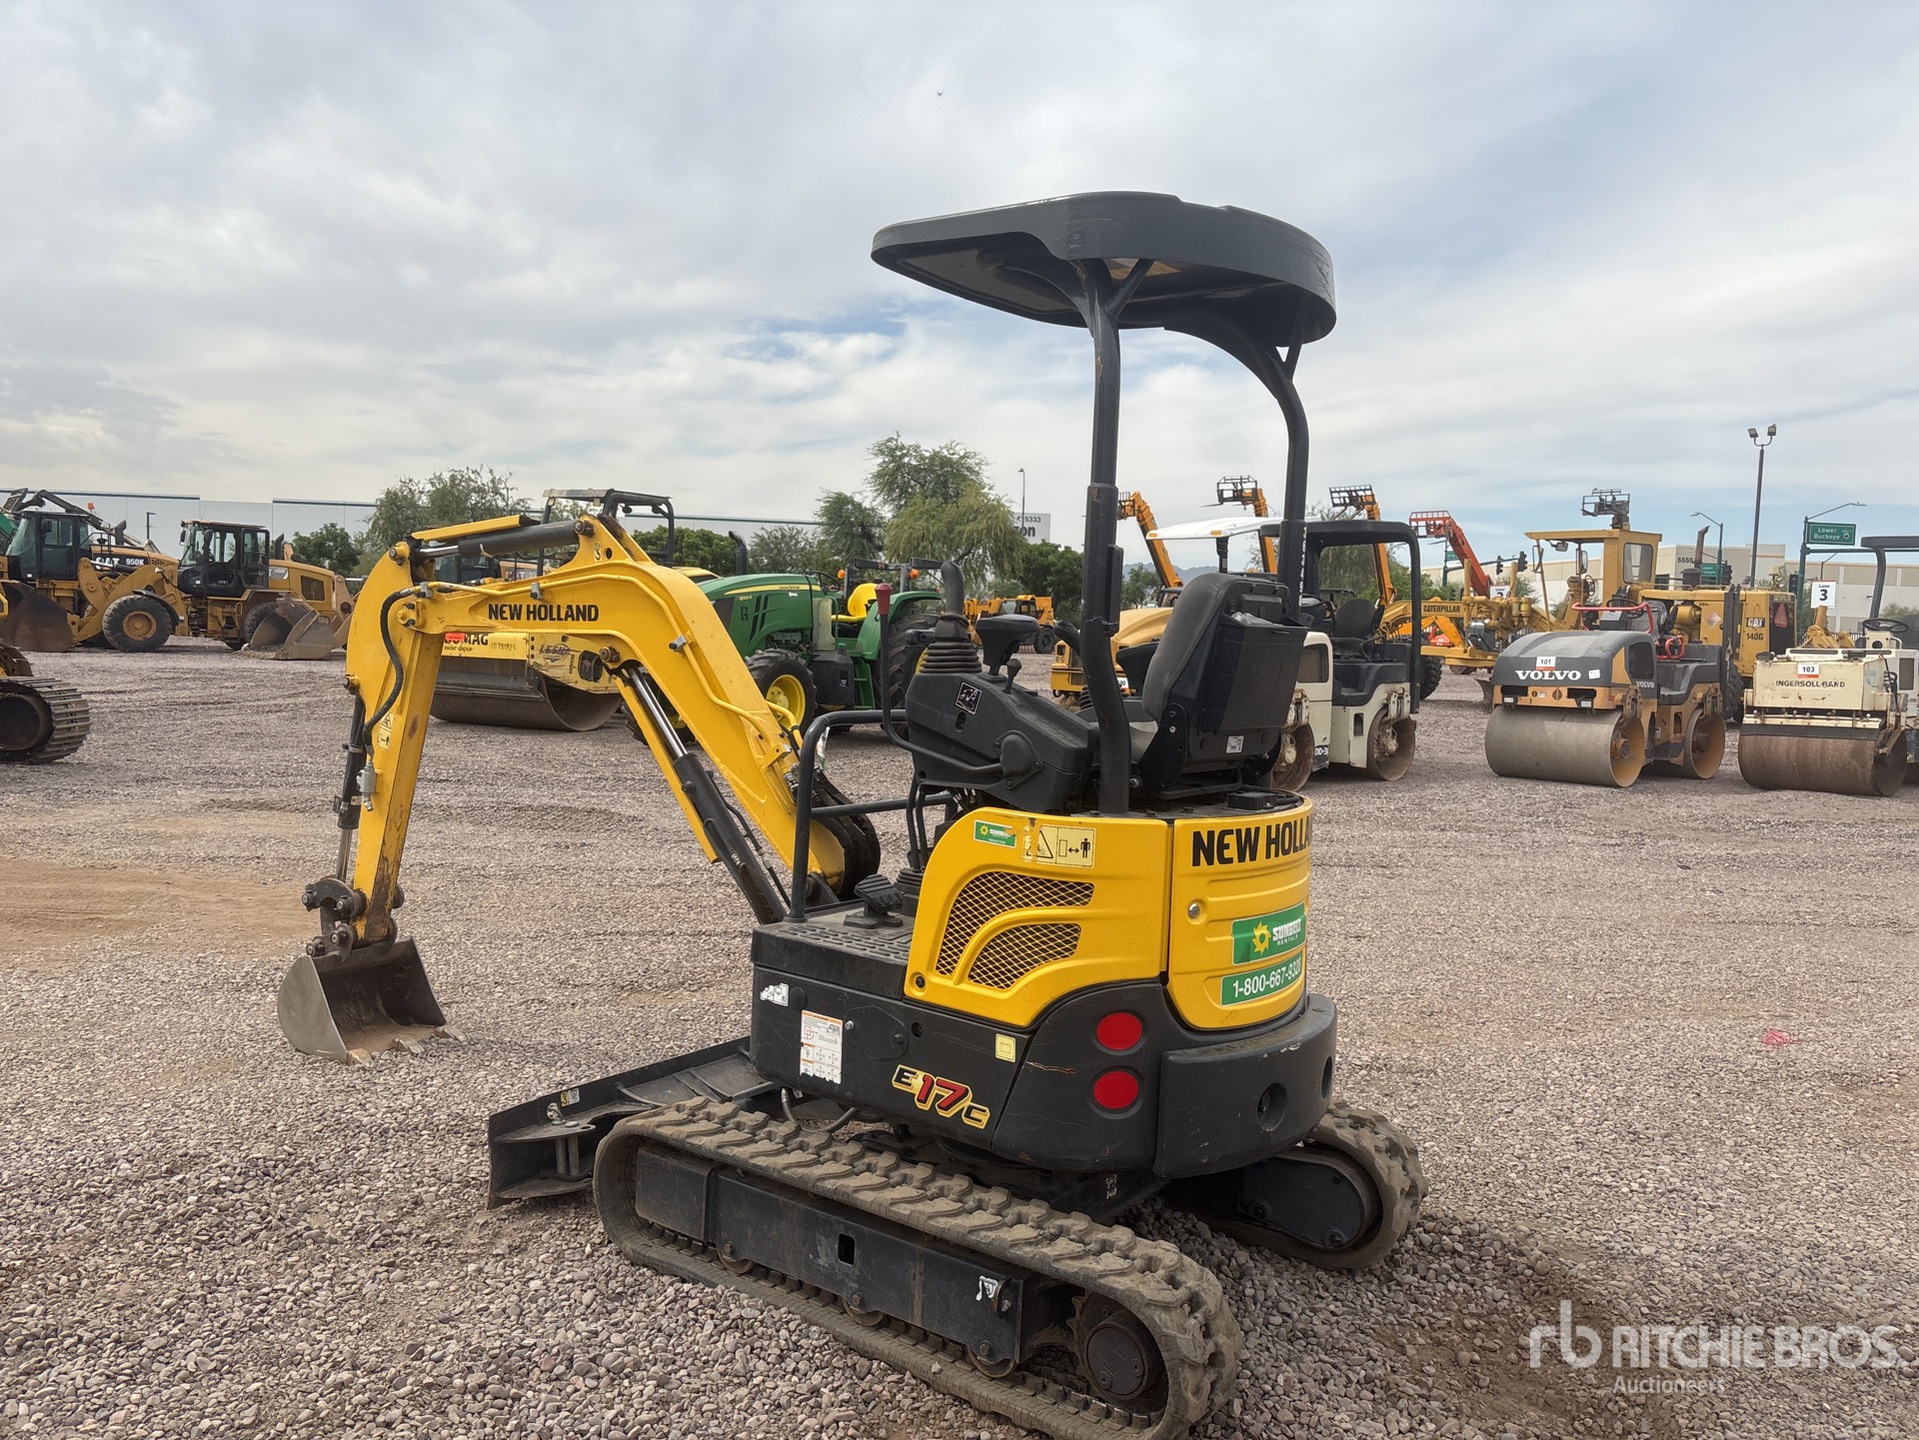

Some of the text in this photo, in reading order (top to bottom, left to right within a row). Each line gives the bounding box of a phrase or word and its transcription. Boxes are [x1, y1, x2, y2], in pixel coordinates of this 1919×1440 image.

[125, 558, 145, 566] 950K
[1819, 589, 1828, 601] 3
[488, 603, 600, 622] NEW HOLLAND
[1423, 605, 1461, 613] CATERPILLAR
[1747, 618, 1762, 627] CAT
[1515, 670, 1582, 681] VOLVO
[1191, 826, 1261, 867] NEW
